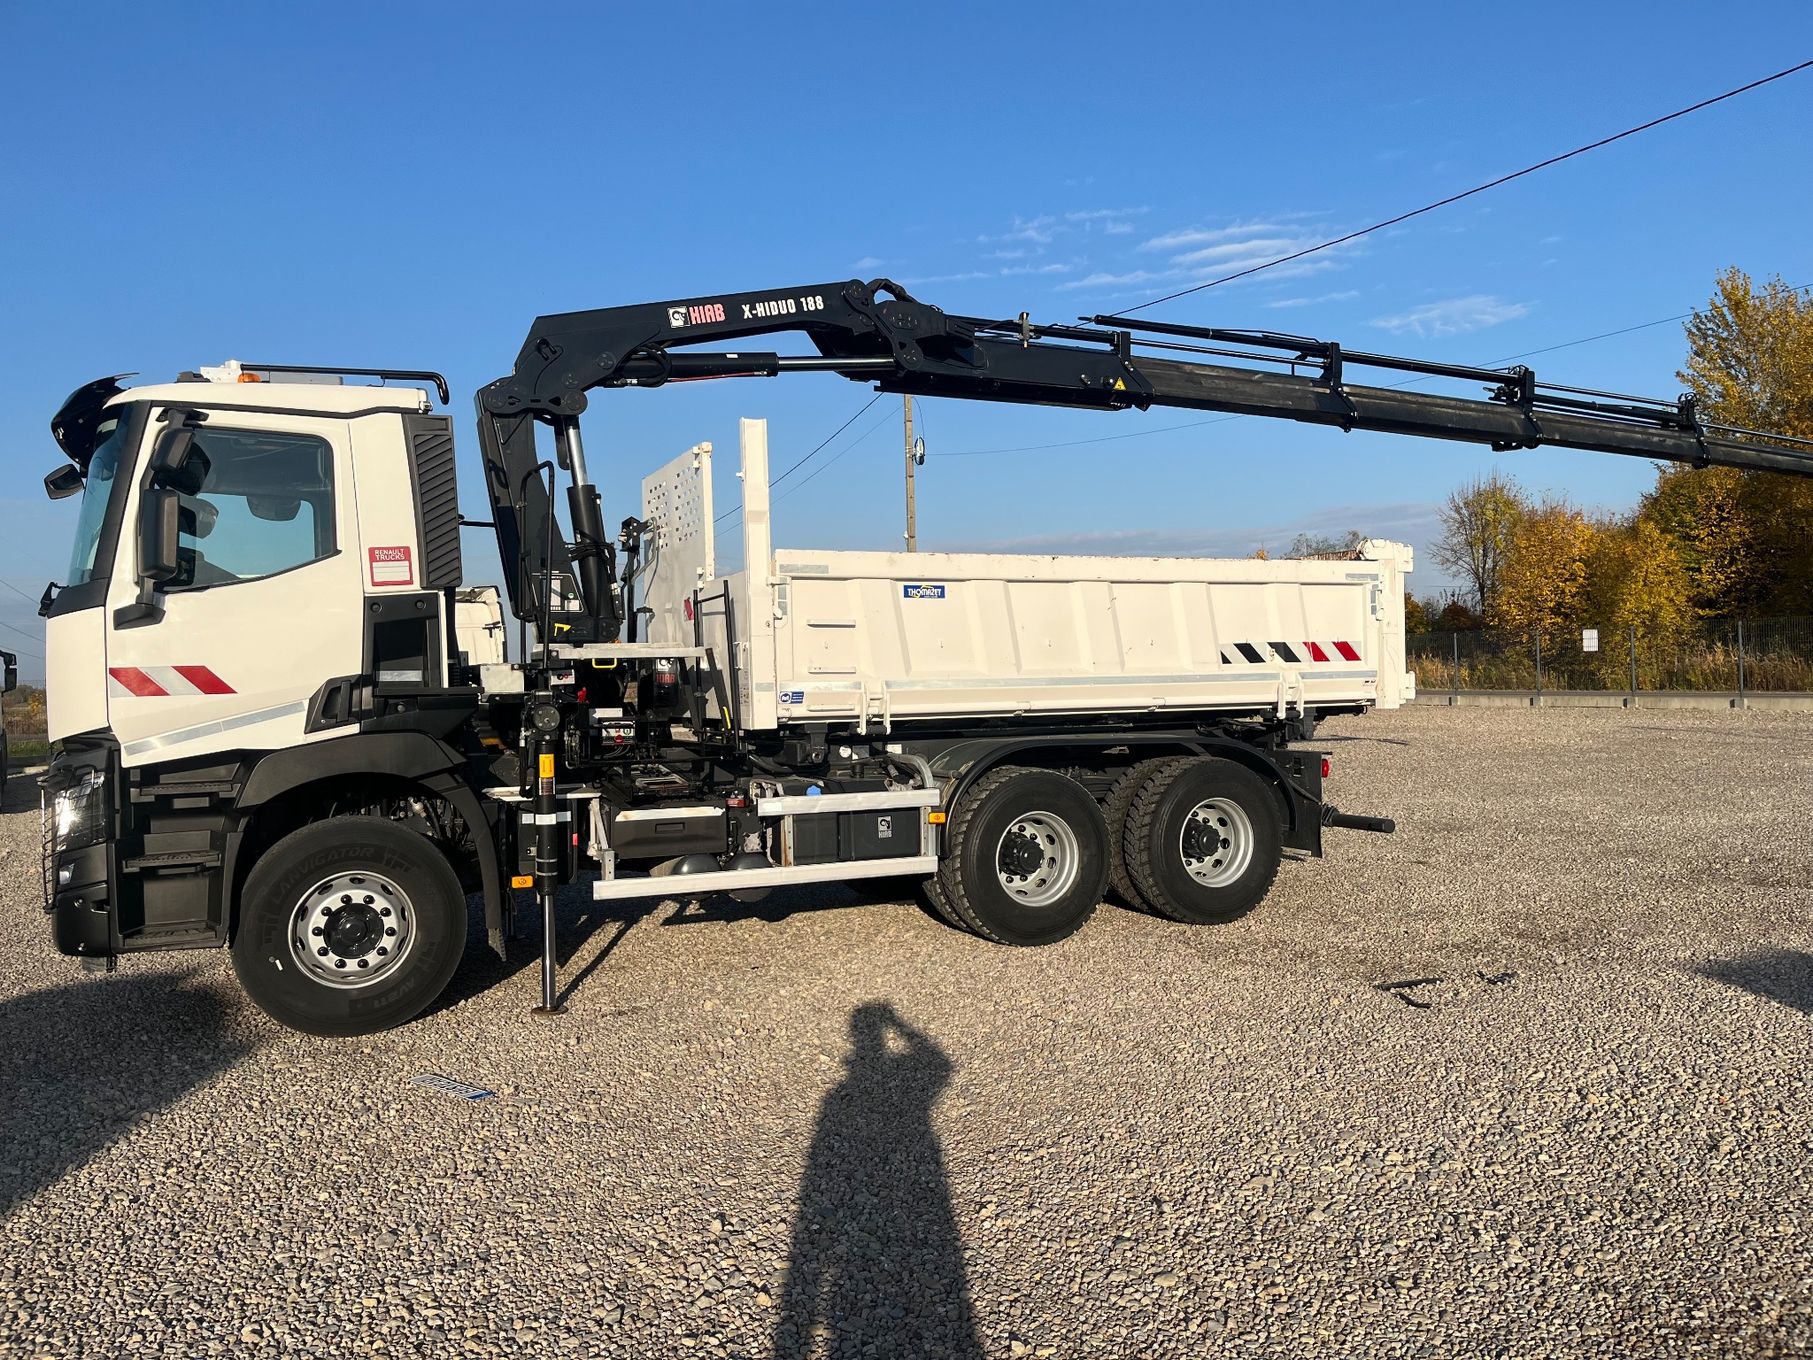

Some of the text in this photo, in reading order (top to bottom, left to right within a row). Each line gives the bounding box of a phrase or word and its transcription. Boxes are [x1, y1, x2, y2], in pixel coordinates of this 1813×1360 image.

[689, 303, 726, 324] HIAB
[741, 295, 825, 320] X-HIDUO 188
[656, 673, 675, 683] HIAB
[272, 847, 375, 904] LANVIGATOR
